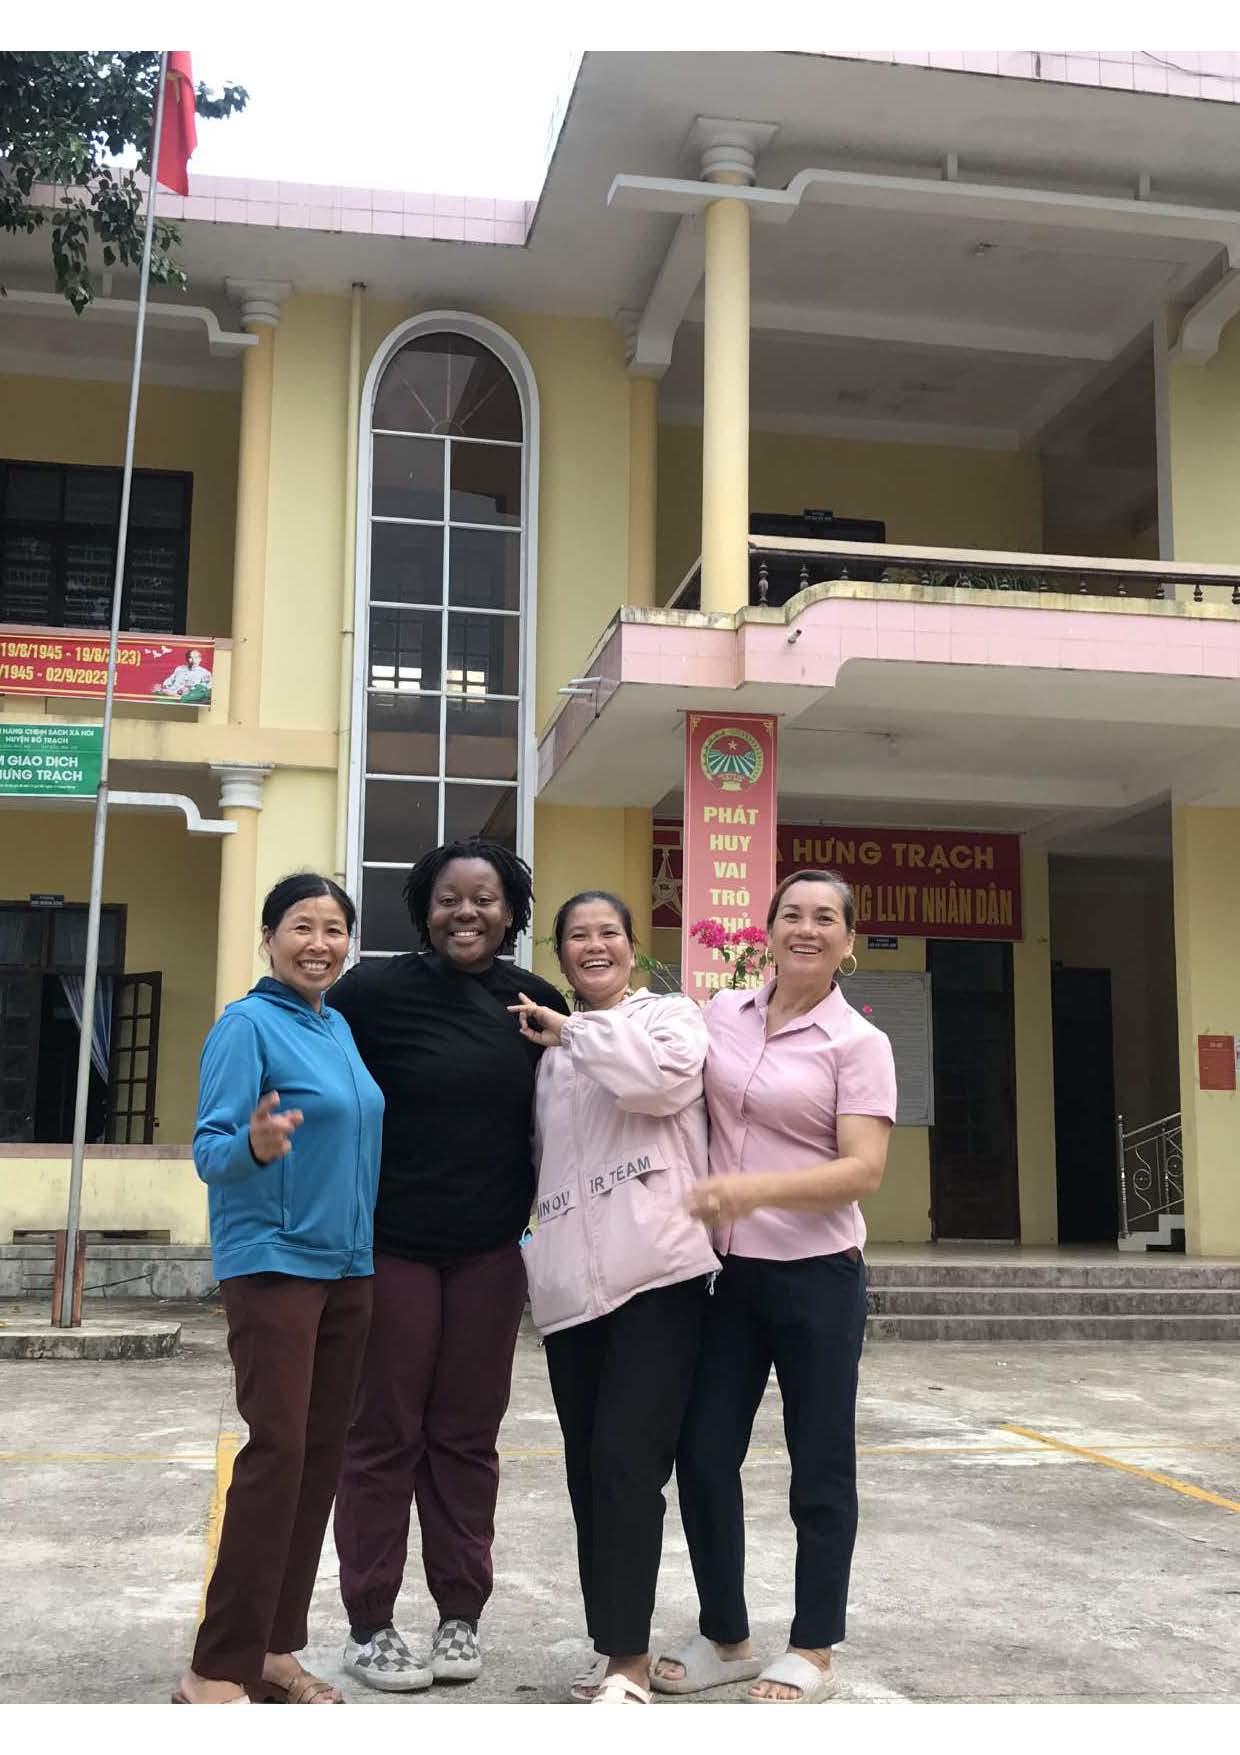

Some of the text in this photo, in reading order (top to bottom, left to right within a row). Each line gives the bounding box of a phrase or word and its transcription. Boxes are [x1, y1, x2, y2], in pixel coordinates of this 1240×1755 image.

[7, 755, 43, 767] GIAO
[45, 756, 78, 768] DỊCH
[36, 770, 83, 784] TRẠCH
[703, 804, 759, 825] PHÁT
[709, 833, 752, 852] HUY
[793, 836, 882, 865] HƯNG
[892, 843, 994, 874] TRẠCH
[713, 861, 747, 879] VAI
[710, 886, 750, 907] TRÒ
[877, 885, 918, 922] LLVT
[922, 882, 972, 926] NHÂN
[976, 881, 1013, 926] DÂN
[609, 1156, 651, 1184] TEAM
